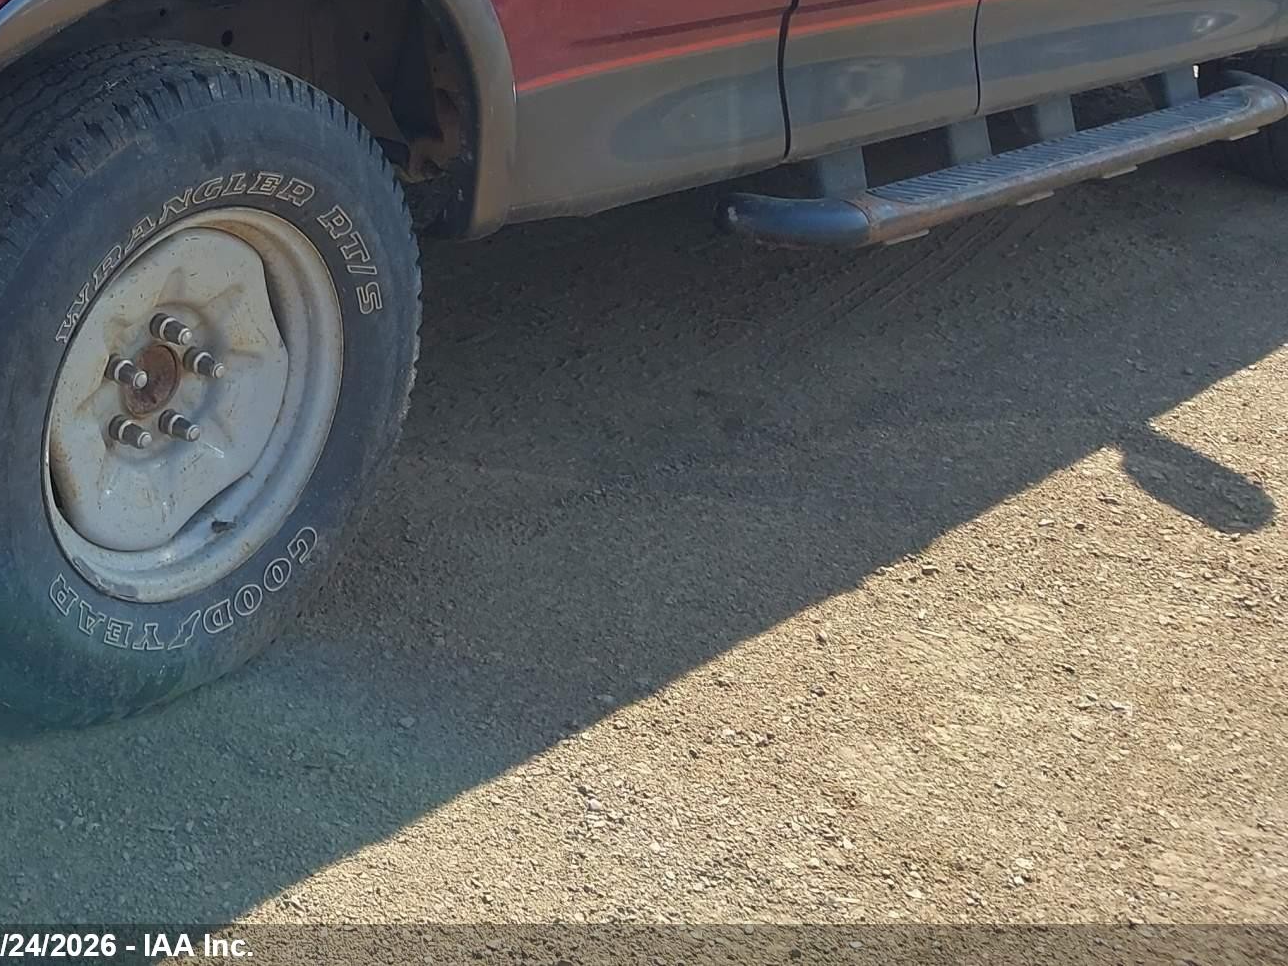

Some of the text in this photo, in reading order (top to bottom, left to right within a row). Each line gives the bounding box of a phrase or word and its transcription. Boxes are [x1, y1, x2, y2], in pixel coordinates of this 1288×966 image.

[55, 172, 383, 344] WRANGLER RT/S
[49, 527, 318, 650] GOODYEAR
